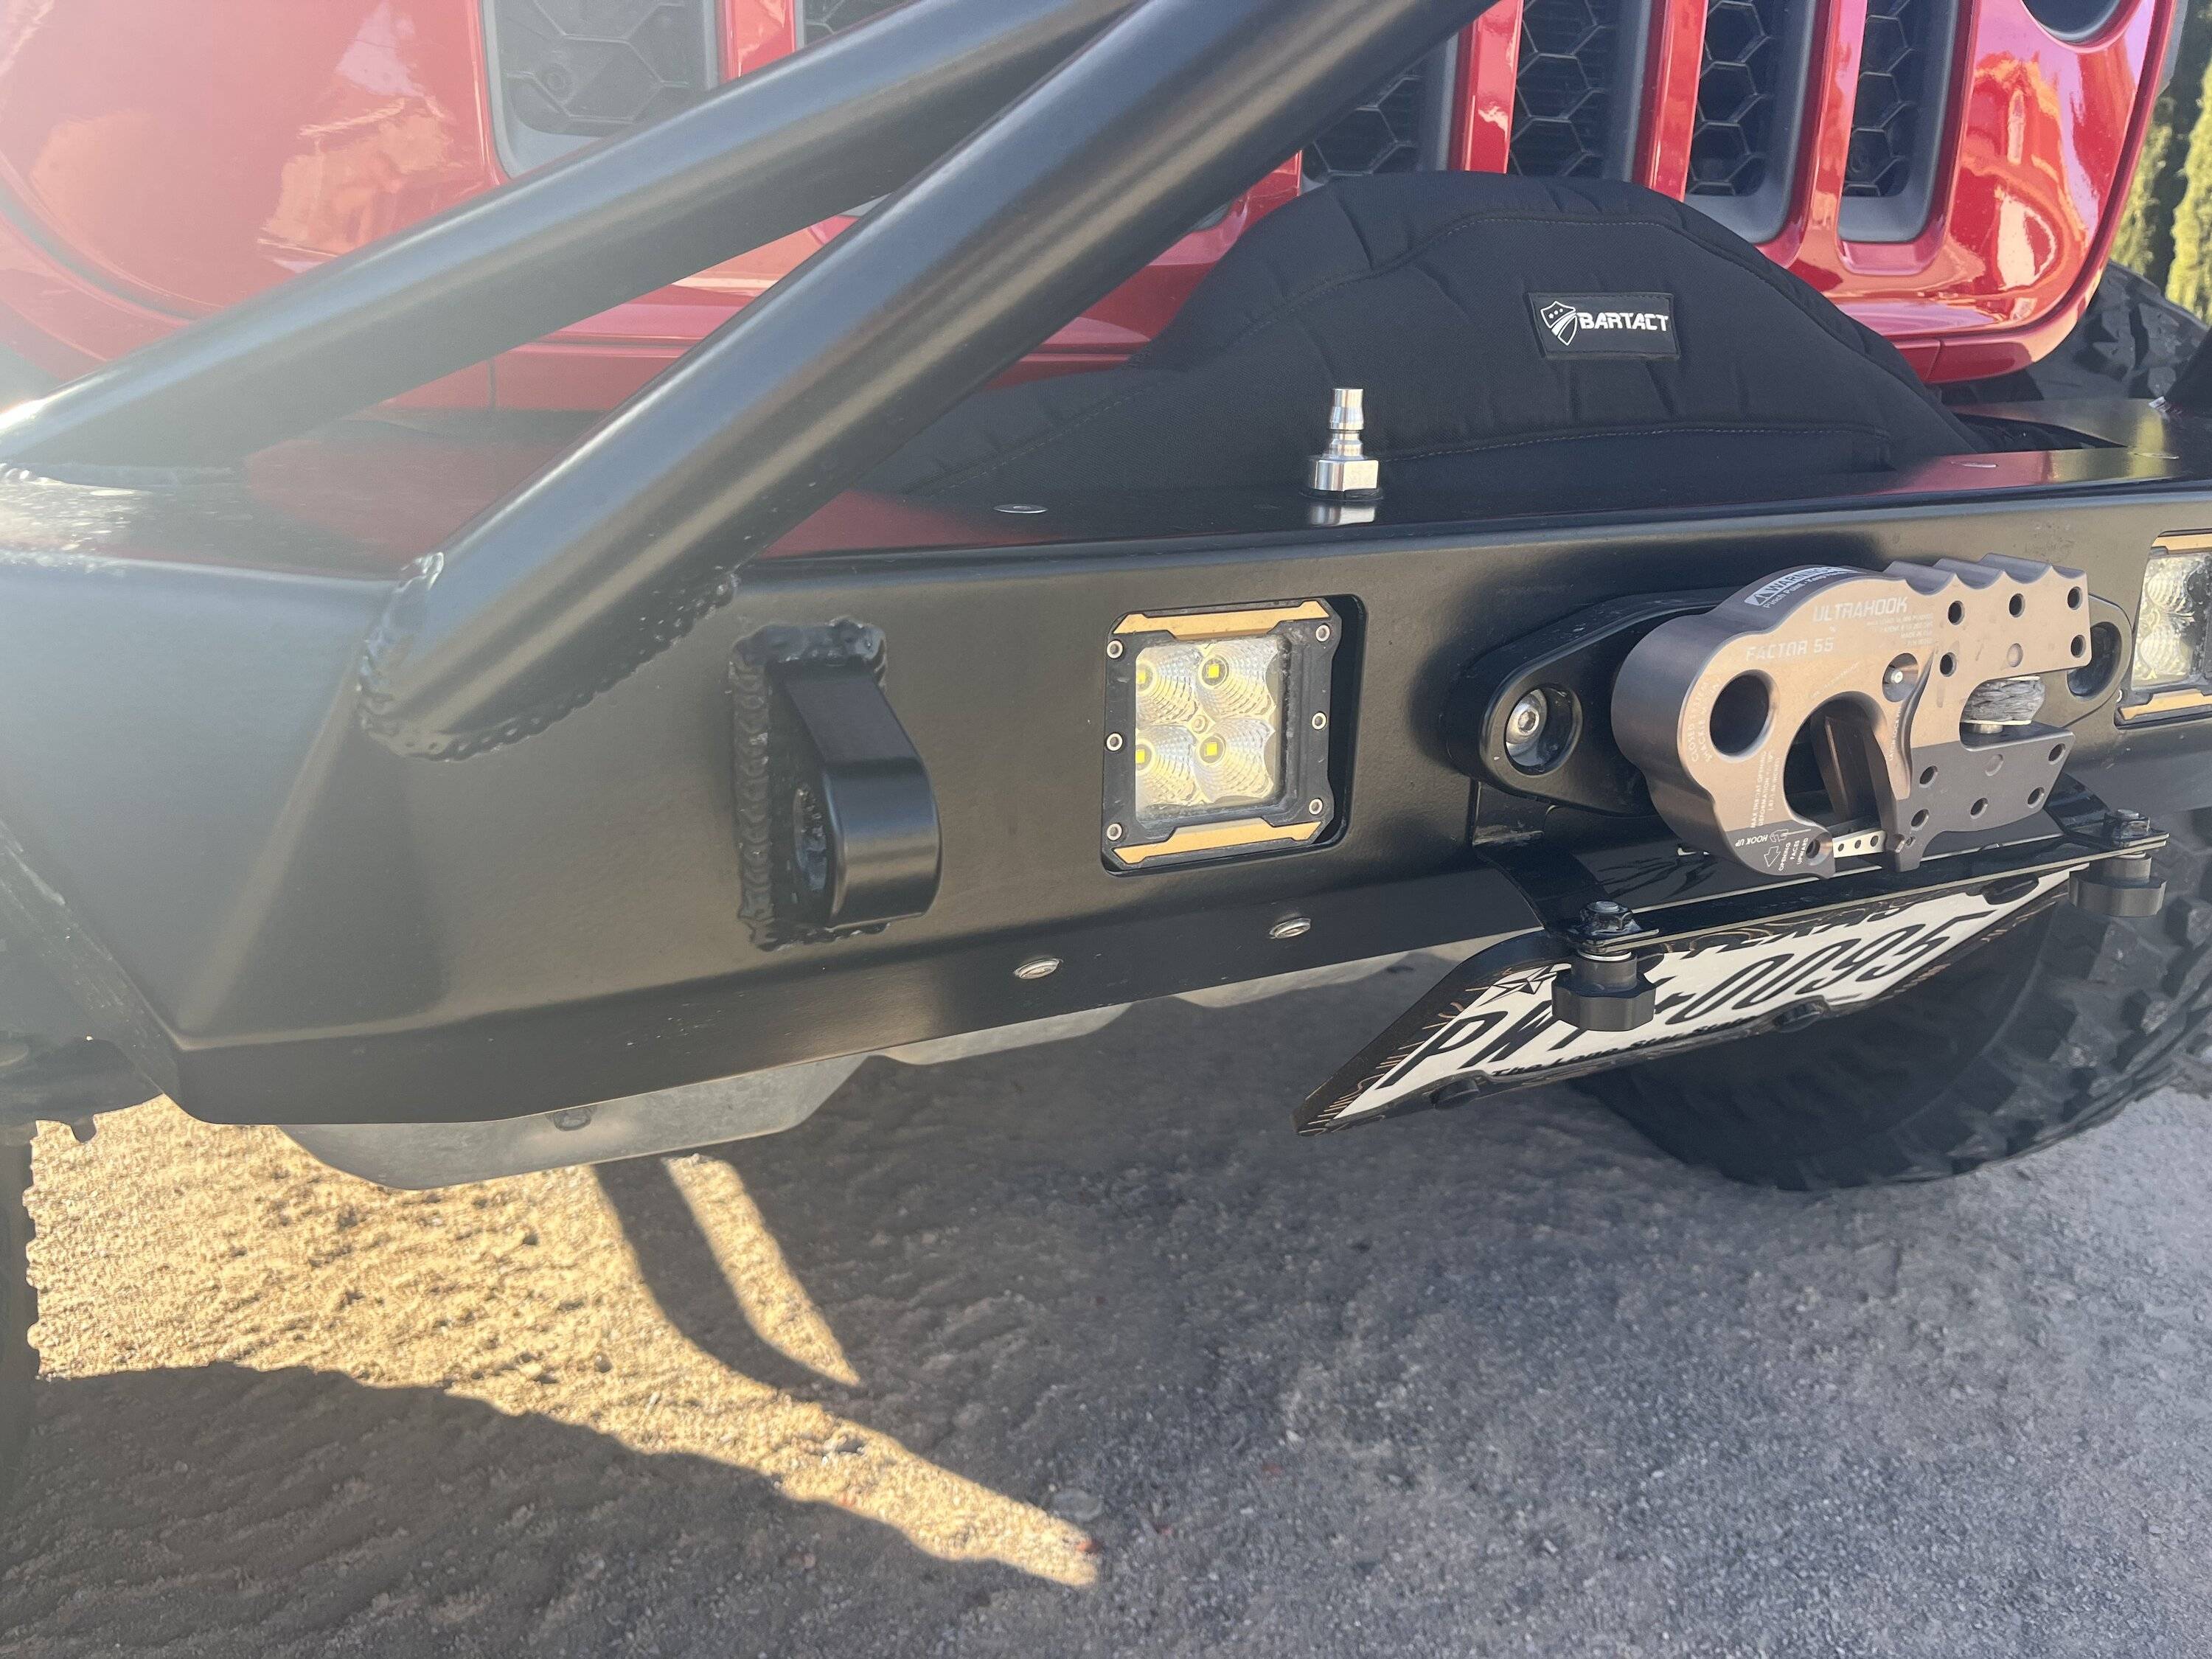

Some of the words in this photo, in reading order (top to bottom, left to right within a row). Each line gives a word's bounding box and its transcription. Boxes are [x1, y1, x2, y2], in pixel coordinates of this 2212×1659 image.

[1576, 312, 1669, 332] BARTACT
[1813, 597, 1908, 622] ULTRAHOOK
[1746, 640, 1808, 661] FACTOR
[1814, 637, 1834, 653] 55
[1735, 838, 1745, 847] UP
[1747, 834, 1769, 845] HOOK
[1778, 842, 1791, 871] OPENING
[1666, 909, 1997, 1025] 0095
